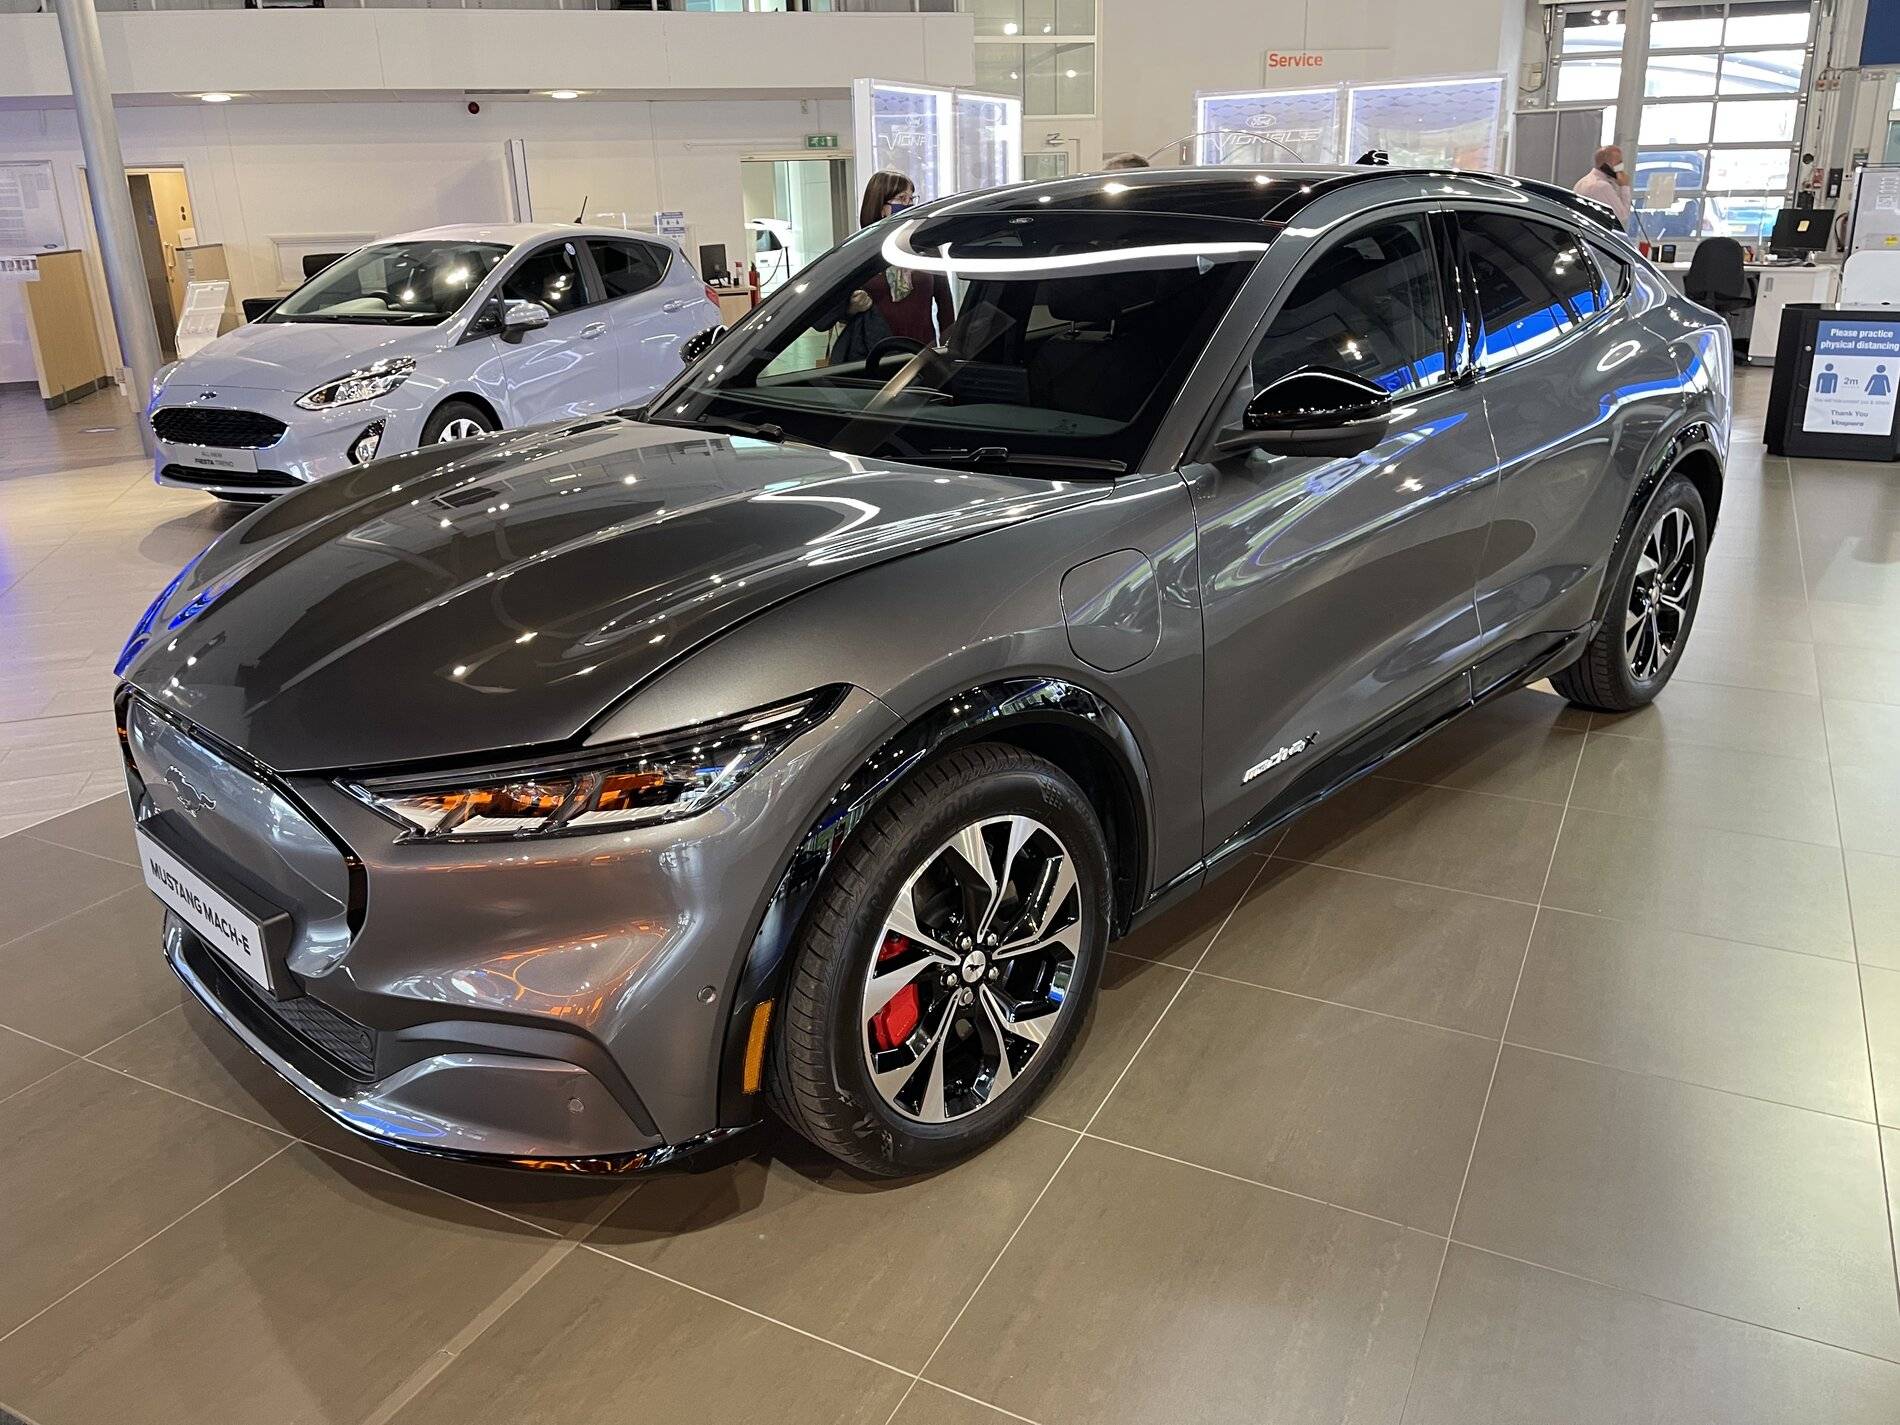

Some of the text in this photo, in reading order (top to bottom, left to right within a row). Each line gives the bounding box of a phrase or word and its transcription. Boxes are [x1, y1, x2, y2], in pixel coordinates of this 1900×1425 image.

[1268, 52, 1323, 67] Service
[1831, 328, 1893, 339] Please practice
[1820, 341, 1900, 351] physical distancing
[1843, 377, 1859, 386] 2m
[150, 858, 251, 957] MUSTANG MACH-E
